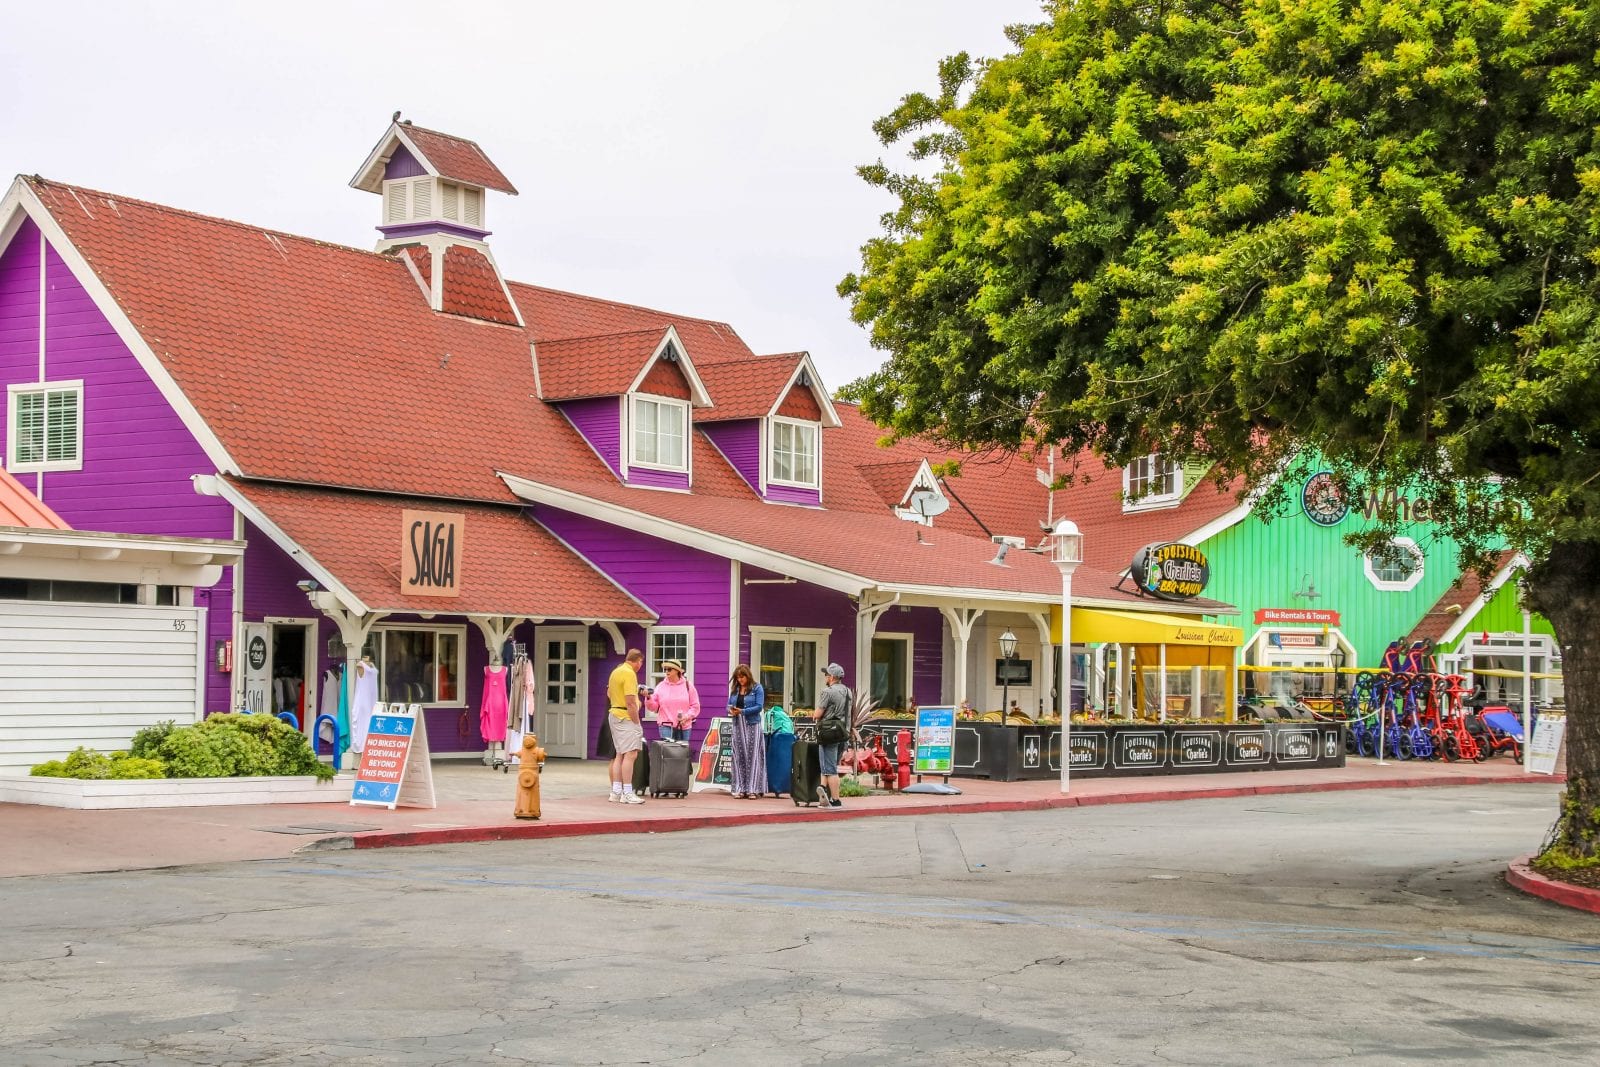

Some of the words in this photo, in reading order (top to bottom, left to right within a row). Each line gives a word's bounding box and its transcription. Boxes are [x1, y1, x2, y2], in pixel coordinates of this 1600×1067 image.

[409, 521, 454, 587] SAGA
[1158, 545, 1206, 568] LOUISIANA
[1164, 560, 1201, 582] Charlie's
[172, 619, 186, 631] 435
[1175, 628, 1204, 641] Louisiana
[1208, 630, 1234, 643] Charlie's
[1070, 738, 1096, 750] UISIANA
[1125, 738, 1156, 750] LOUISIANA
[1183, 737, 1211, 749] LOUISIANA
[1236, 736, 1262, 748] LOUISIANA
[1286, 735, 1311, 746] LOUISIANA
[368, 749, 402, 758] SIDEWALK
[1129, 749, 1153, 761] Charlie's
[1186, 748, 1208, 760] Charlie's
[1240, 746, 1260, 759] Charlie's
[1289, 745, 1308, 757] Charlie's
[368, 760, 396, 768] BEYOND
[362, 769, 376, 777] THIS
[378, 770, 399, 778] POINT
